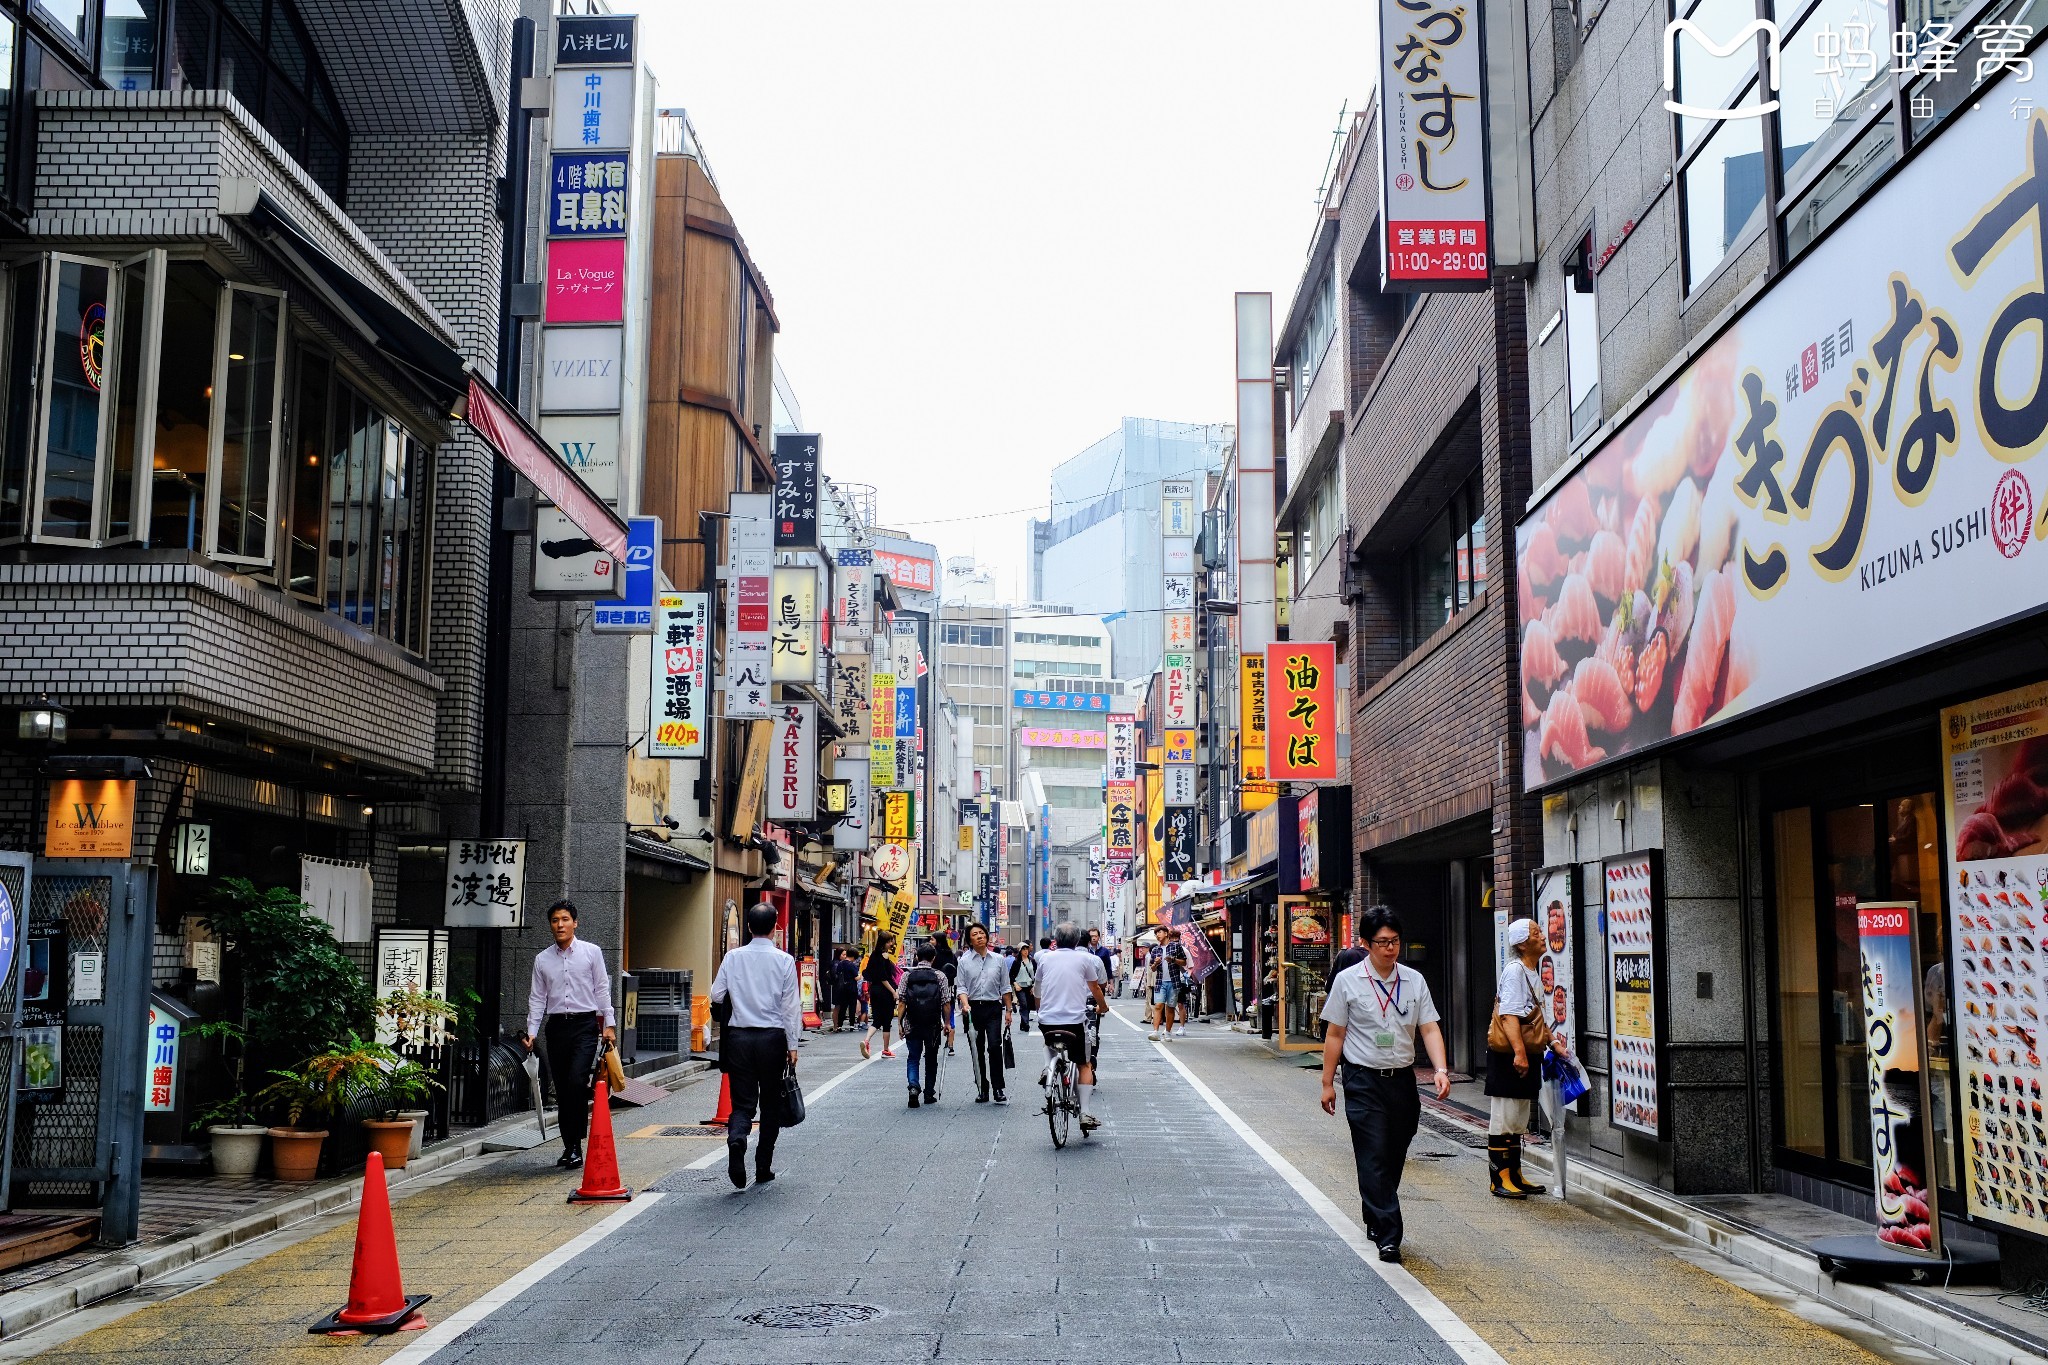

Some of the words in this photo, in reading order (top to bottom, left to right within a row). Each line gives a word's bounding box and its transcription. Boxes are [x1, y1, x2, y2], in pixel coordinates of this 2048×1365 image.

[562, 33, 629, 51] 八洋ビル
[582, 73, 602, 145] 中川歯科
[1398, 92, 1407, 133] KIZUNA
[1400, 135, 1408, 170] SUSHI
[583, 161, 626, 189] 新宿
[556, 190, 626, 231] 耳鼻科
[1398, 229, 1477, 246] 営業時間
[1734, 117, 2048, 592] きづなす
[777, 460, 801, 519] すみれ
[1860, 538, 1924, 592] KIZUNA
[1931, 506, 1987, 560] SUSHI
[846, 582, 860, 627] さくら水産
[1170, 616, 1181, 643] 吉本
[664, 610, 695, 721] 一軒め酒場
[1184, 656, 1192, 692] ステーキ
[1023, 693, 1102, 709] カラオケ館
[1167, 668, 1183, 720] パンドラ
[1285, 655, 1319, 767] 油そば
[872, 687, 883, 739] はんこ店
[1028, 731, 1107, 747] マンガ・ネット
[1166, 749, 1192, 761] 松屋
[782, 706, 800, 810] RAKERU
[55, 819, 67, 829] Le
[73, 803, 107, 830] W
[189, 828, 207, 873] そば
[459, 843, 518, 865] 手打そば
[889, 846, 902, 873] わんたん
[879, 861, 891, 878] めん
[509, 910, 516, 922] 1
[151, 1023, 176, 1108] 中川歯科
